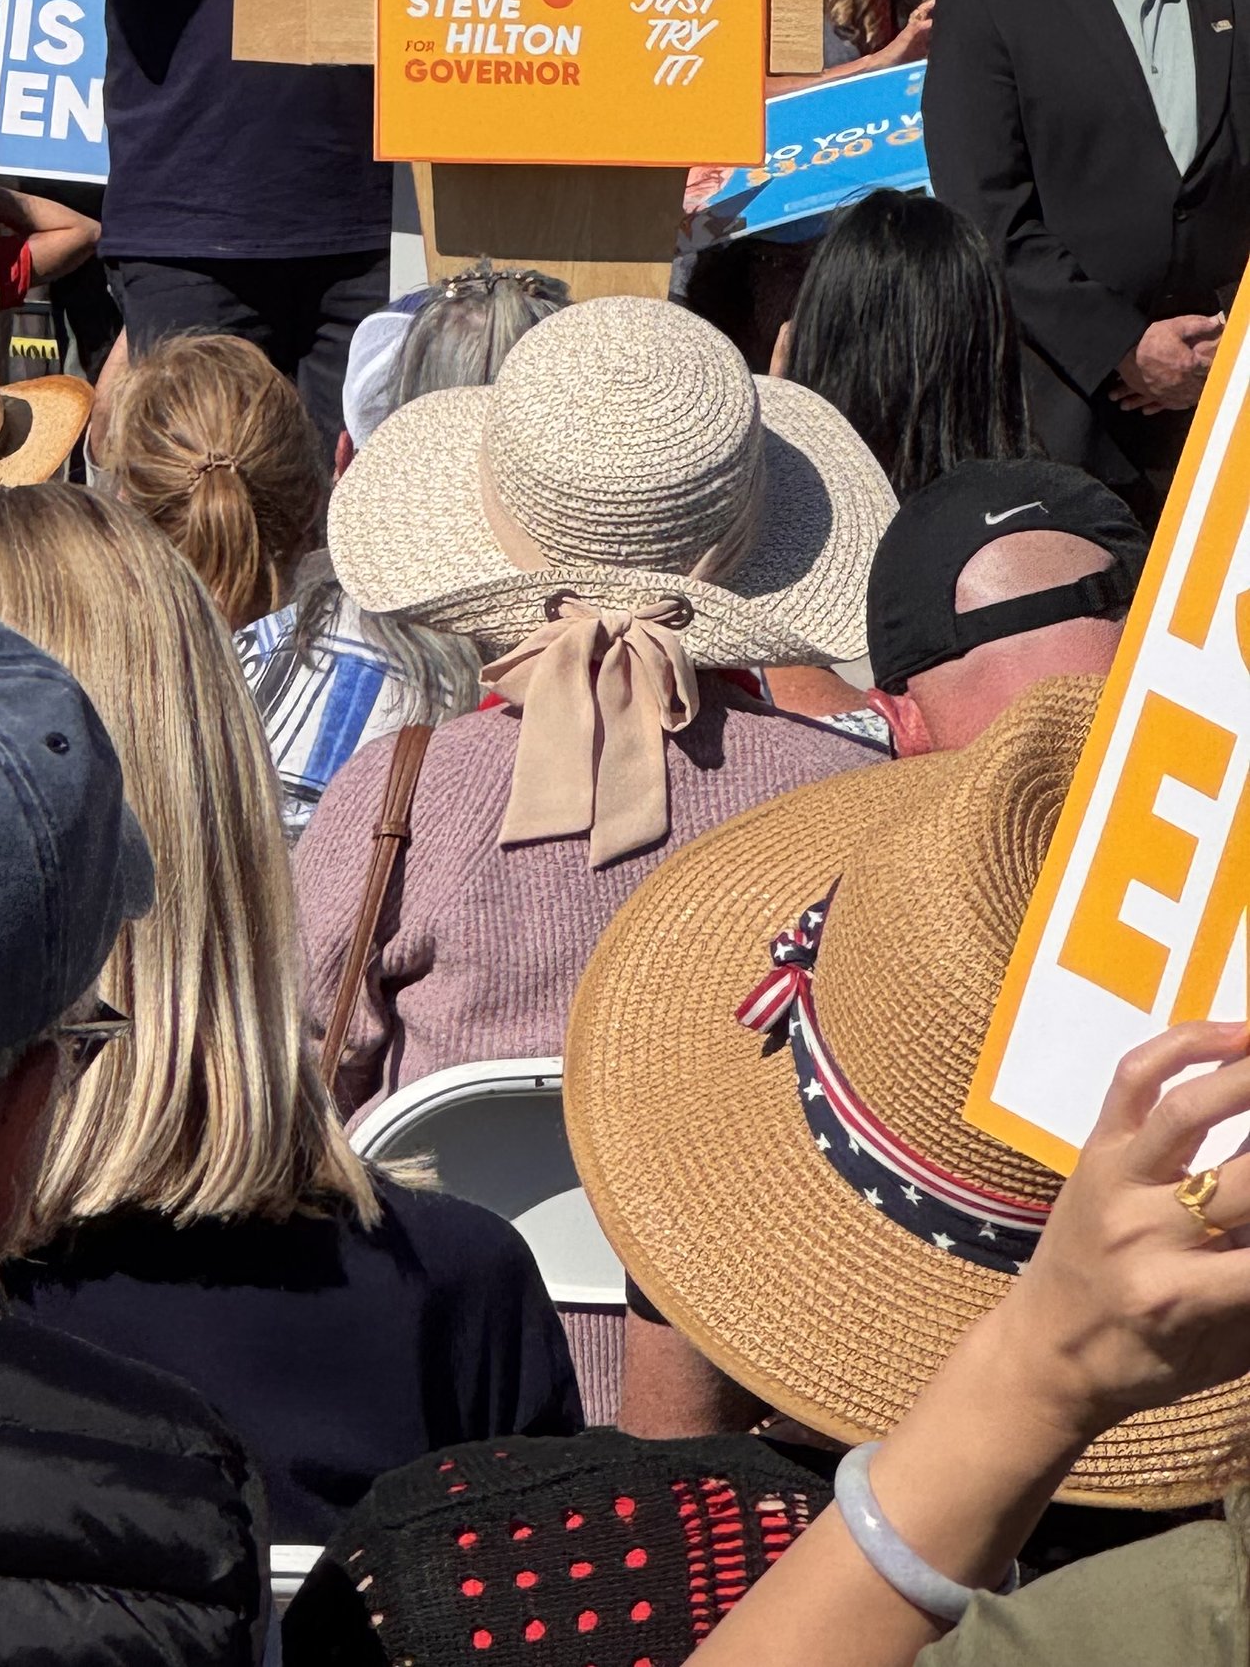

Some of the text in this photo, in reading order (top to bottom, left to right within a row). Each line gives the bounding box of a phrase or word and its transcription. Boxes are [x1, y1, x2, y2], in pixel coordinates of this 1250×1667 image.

[405, 40, 435, 53] FOR
[445, 22, 582, 55] HILTON
[645, 18, 720, 52] TRY
[404, 58, 581, 86] GOVERNOR
[654, 54, 705, 86] IT!
[813, 119, 889, 150] YOU
